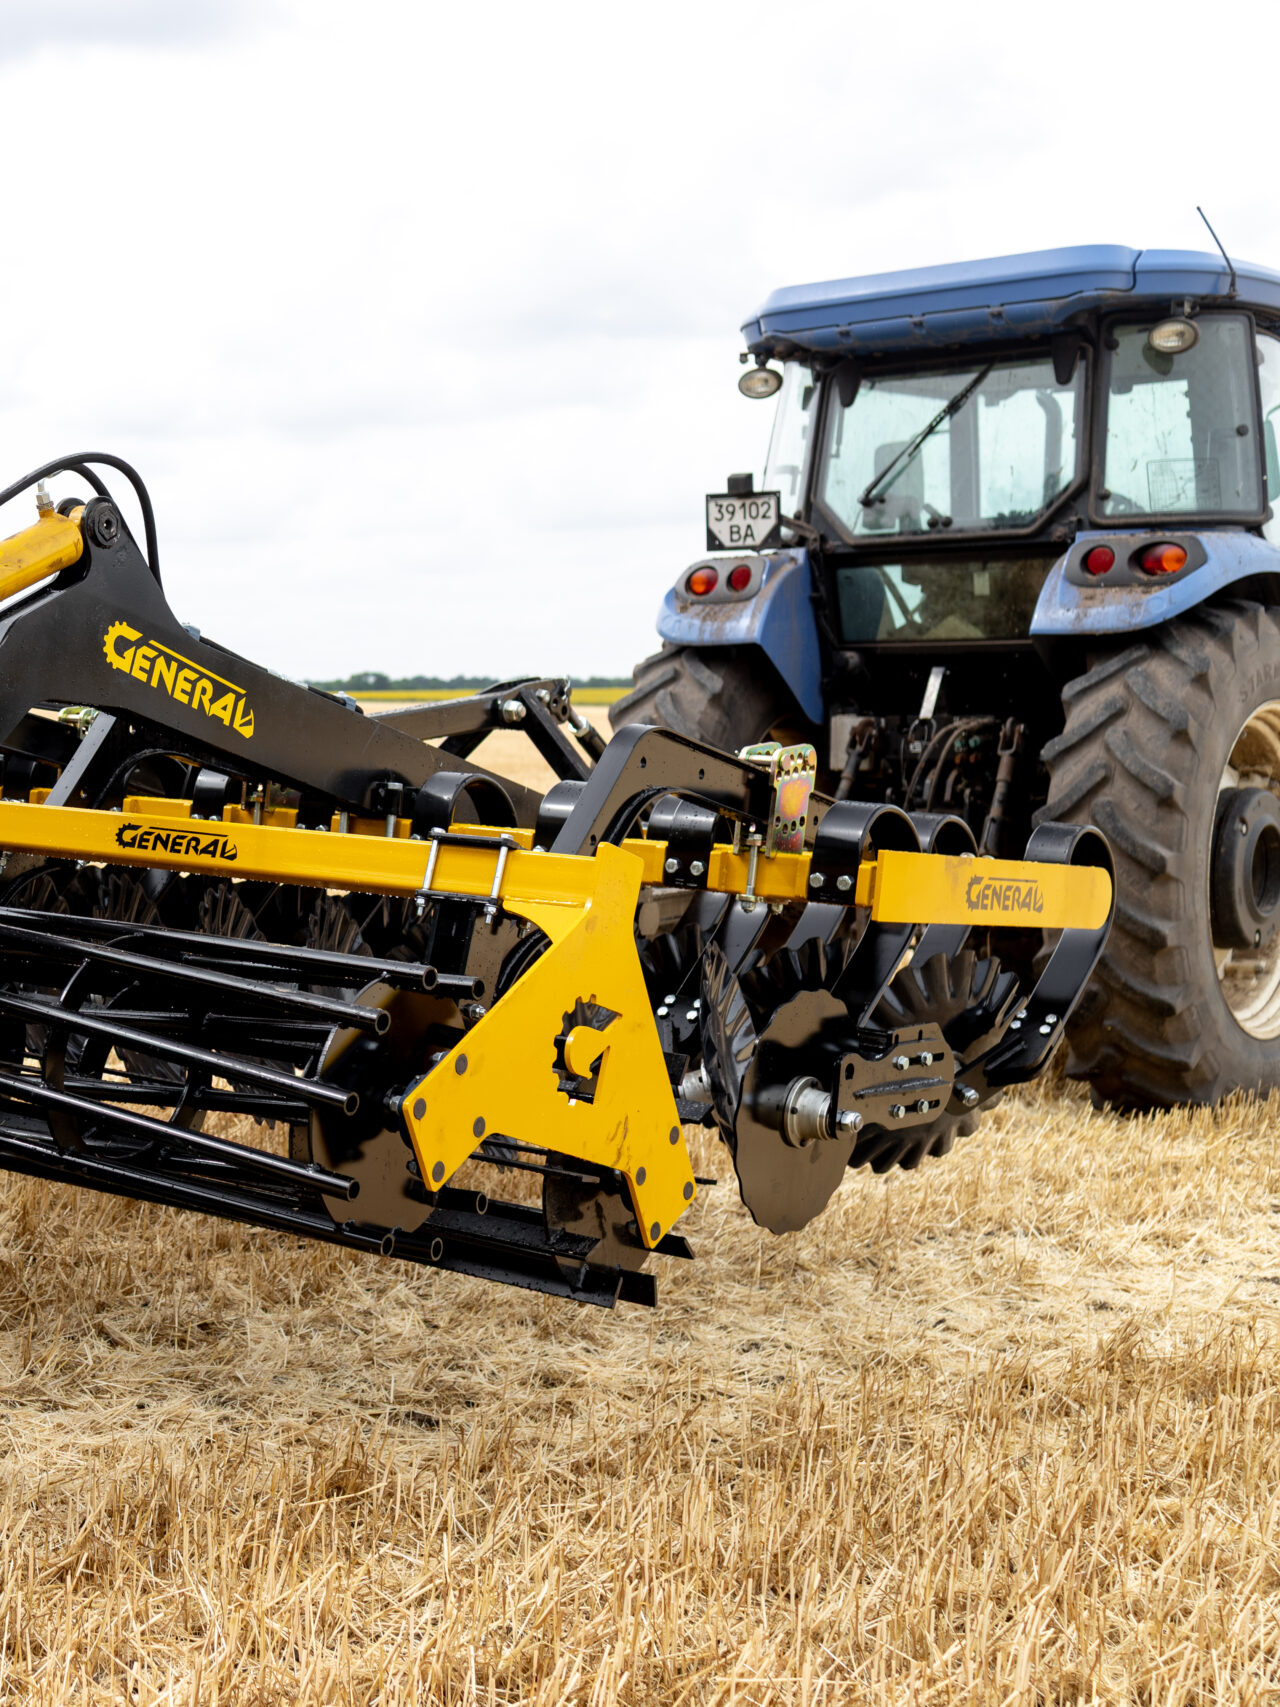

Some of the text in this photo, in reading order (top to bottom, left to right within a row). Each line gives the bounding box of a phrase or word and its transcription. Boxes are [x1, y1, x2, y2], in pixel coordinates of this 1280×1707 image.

[714, 501, 772, 521] 39102
[729, 524, 756, 544] BA
[103, 620, 255, 739] GENERAL
[1239, 663, 1280, 704] STAR
[115, 822, 238, 861] GENERAL
[965, 874, 1044, 914] GENERAL
